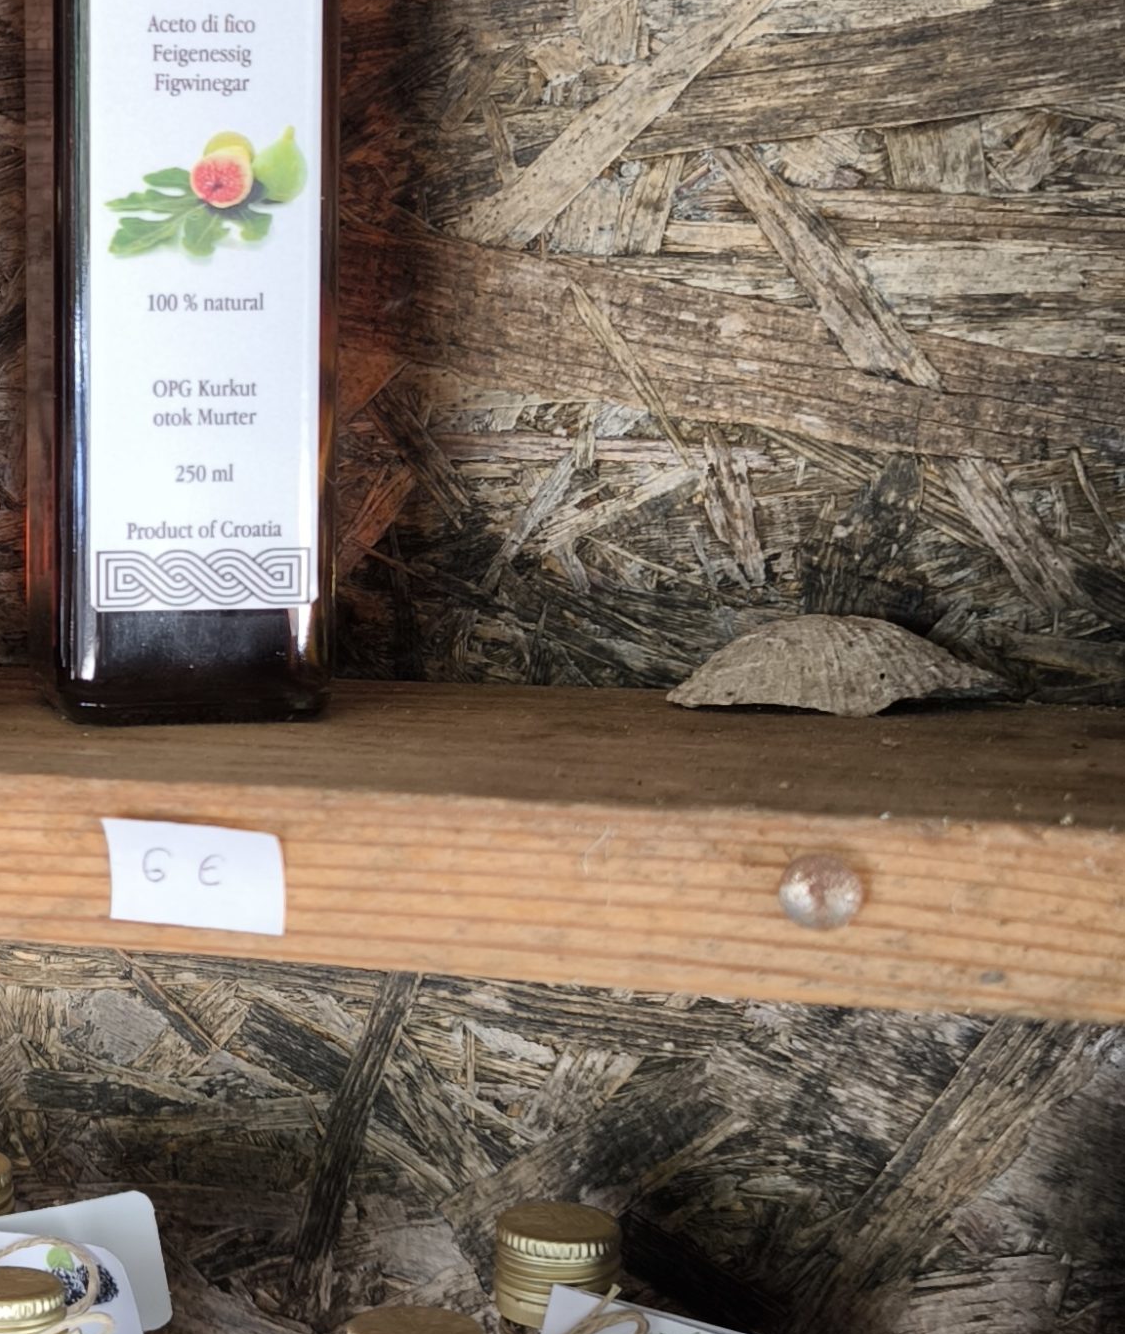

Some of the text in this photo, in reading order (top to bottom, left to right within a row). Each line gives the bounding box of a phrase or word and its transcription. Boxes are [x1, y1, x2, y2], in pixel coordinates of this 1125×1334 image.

[147, 14, 256, 34] Aceto di fico
[152, 44, 252, 67] Feigenessig
[154, 73, 250, 97] Figwinegar
[203, 293, 264, 311] natural
[152, 378, 257, 398] OPG Kurkut
[152, 407, 257, 427] otok Murter
[175, 463, 234, 483] 250 ml
[126, 520, 282, 540] Product of Croatia
